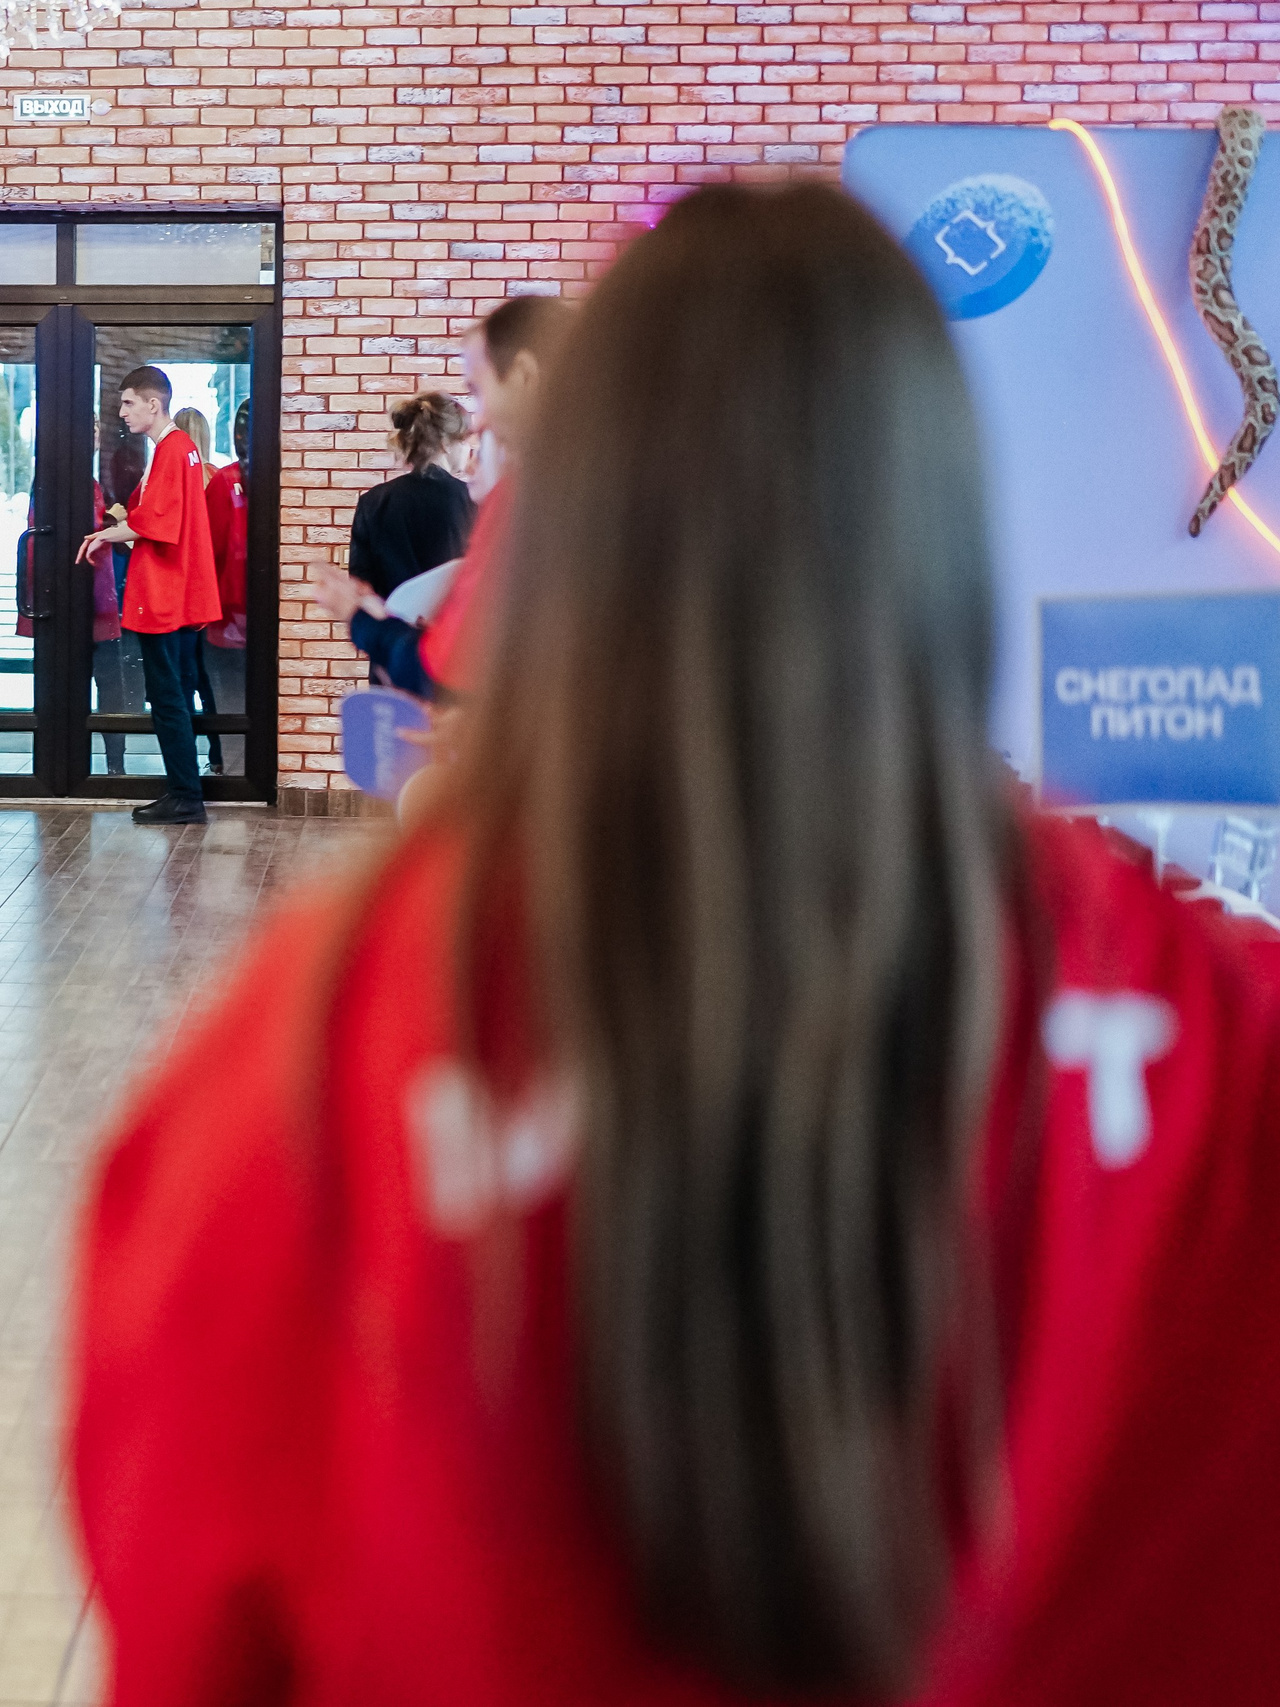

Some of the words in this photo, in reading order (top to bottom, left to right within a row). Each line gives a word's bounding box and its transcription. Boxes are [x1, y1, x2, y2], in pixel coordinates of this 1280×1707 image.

[22, 99, 83, 114] ВЫХОД
[1055, 667, 1262, 708] СНЕГОПАД
[1090, 705, 1224, 740] ПИТОН
[1040, 990, 1182, 1170] Т
